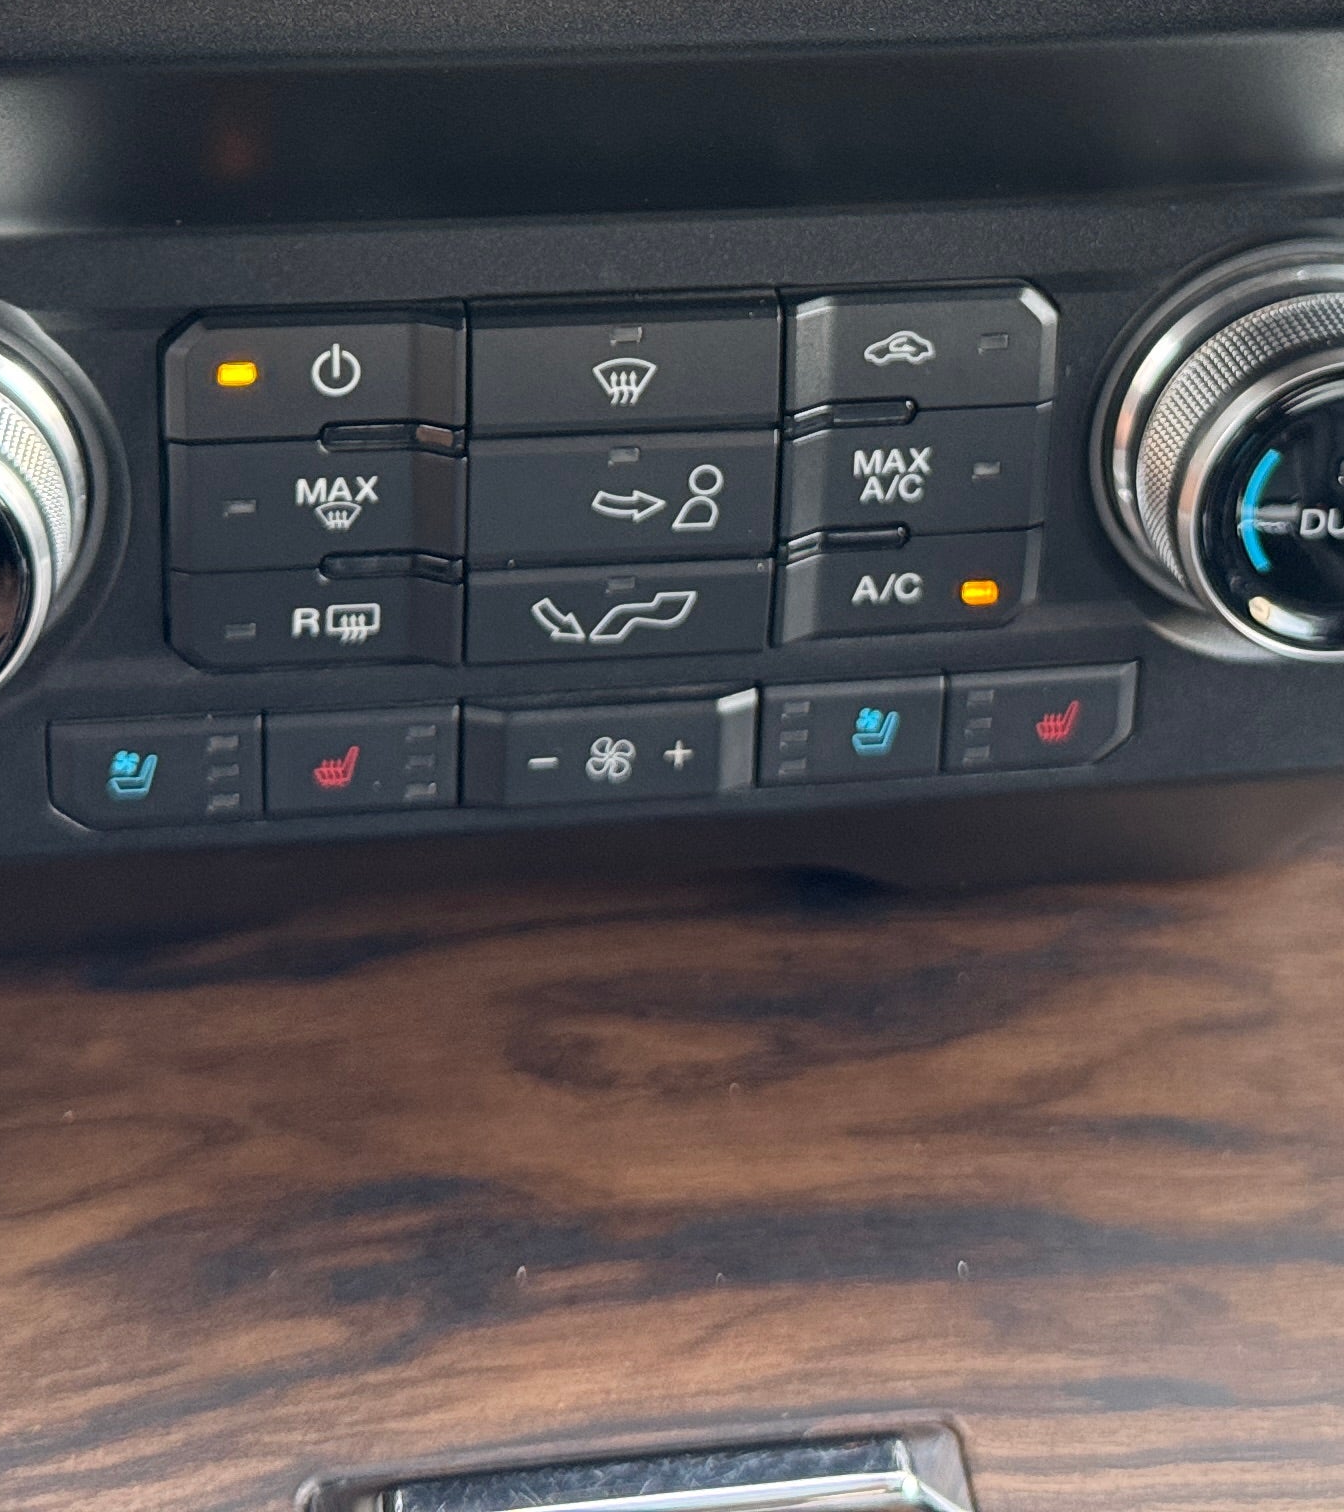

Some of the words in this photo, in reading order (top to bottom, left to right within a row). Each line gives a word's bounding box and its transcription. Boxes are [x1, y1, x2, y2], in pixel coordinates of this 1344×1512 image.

[853, 448, 931, 479] MAX
[296, 477, 379, 506] MAX
[860, 475, 926, 504] A/C
[852, 573, 922, 605] A/C
[293, 608, 318, 637] R
